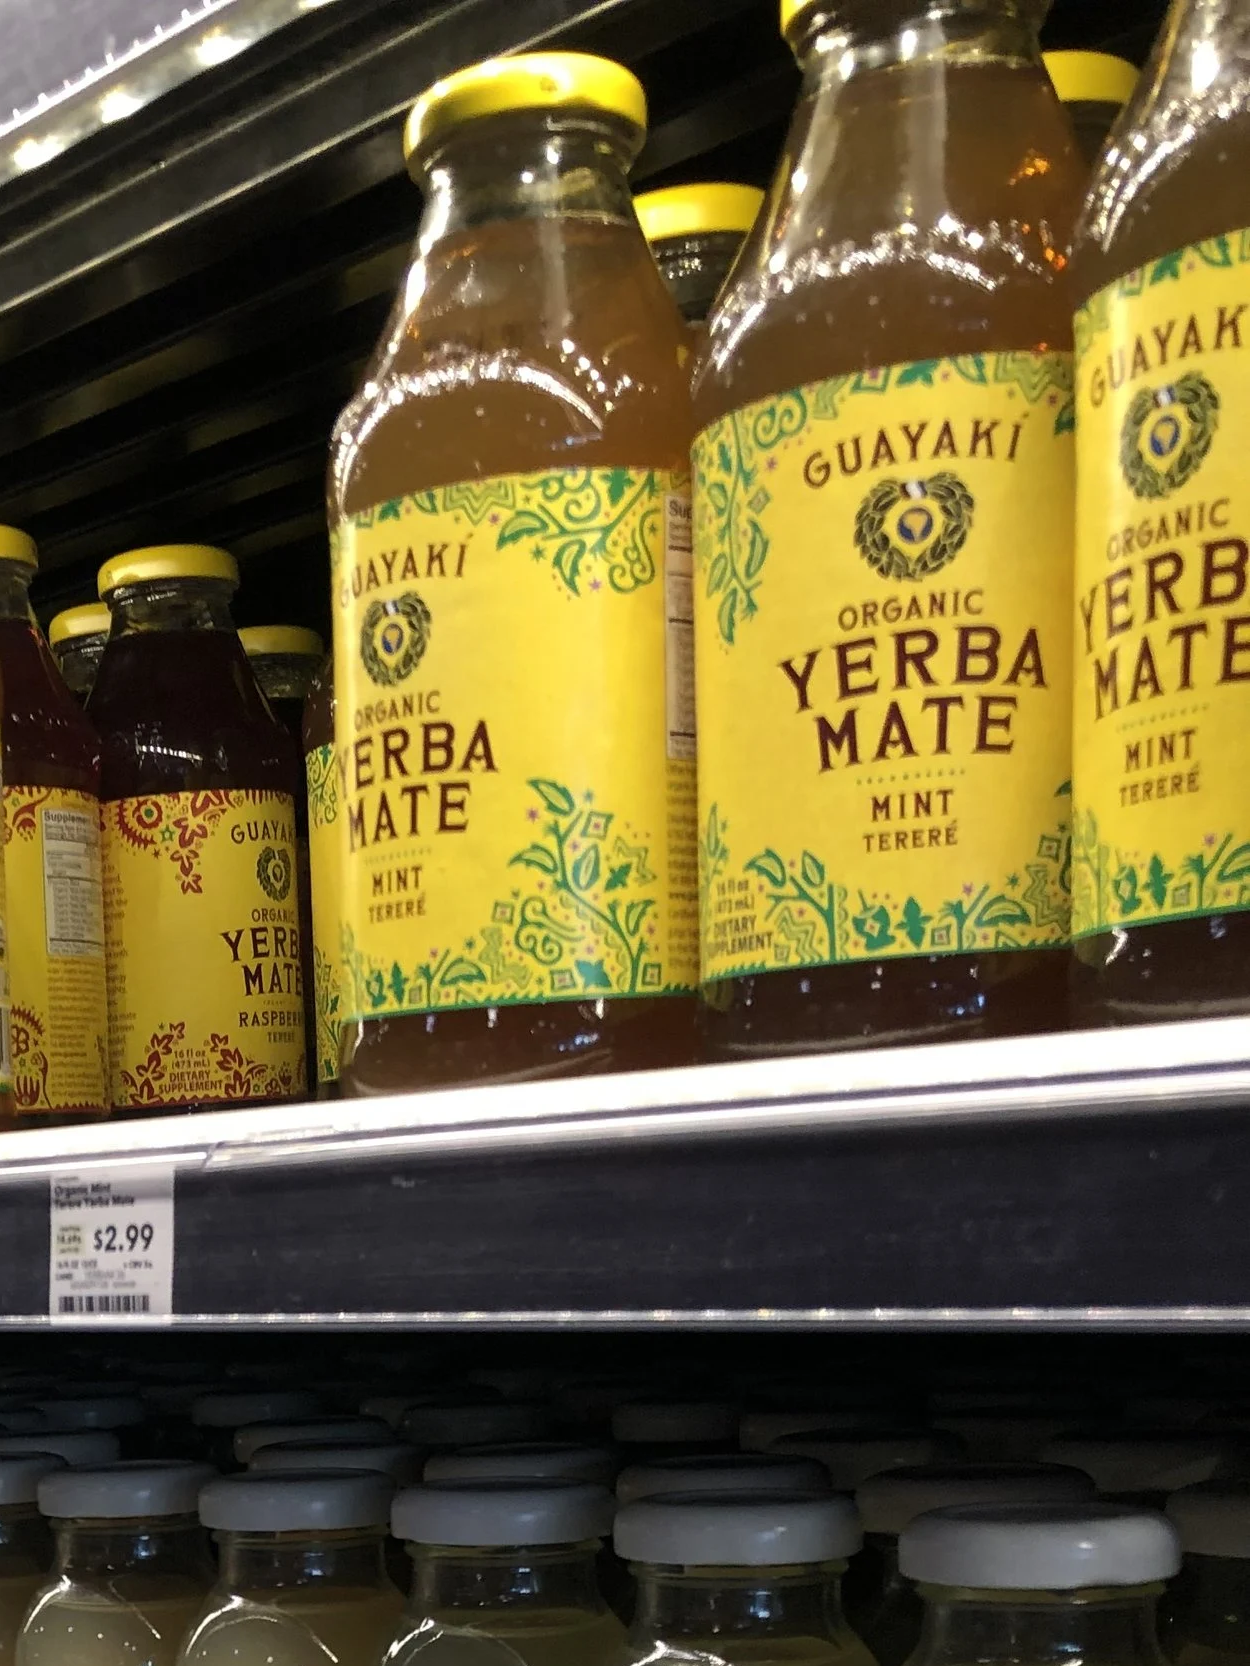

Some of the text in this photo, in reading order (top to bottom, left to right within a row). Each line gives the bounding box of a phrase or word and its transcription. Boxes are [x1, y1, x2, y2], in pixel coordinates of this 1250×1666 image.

[1090, 303, 1250, 408] GUAYAK
[1106, 498, 1230, 562] ORGANIC
[837, 589, 985, 633] ORGANIC
[1080, 537, 1250, 656] YERB
[777, 625, 1049, 714] YERBA
[354, 691, 442, 730] ORGANIC
[814, 696, 1019, 775] MATE
[1125, 729, 1198, 774] MINT
[336, 719, 500, 798] YERBA
[348, 782, 471, 854] MATE
[870, 790, 955, 823] MINT
[862, 821, 959, 854] TERERÉ
[371, 864, 423, 898] MINT
[158, 1080, 222, 1094] SUPPLEMENT
[170, 1070, 210, 1082] DIETARY
[94, 1223, 154, 1252] $2.99
